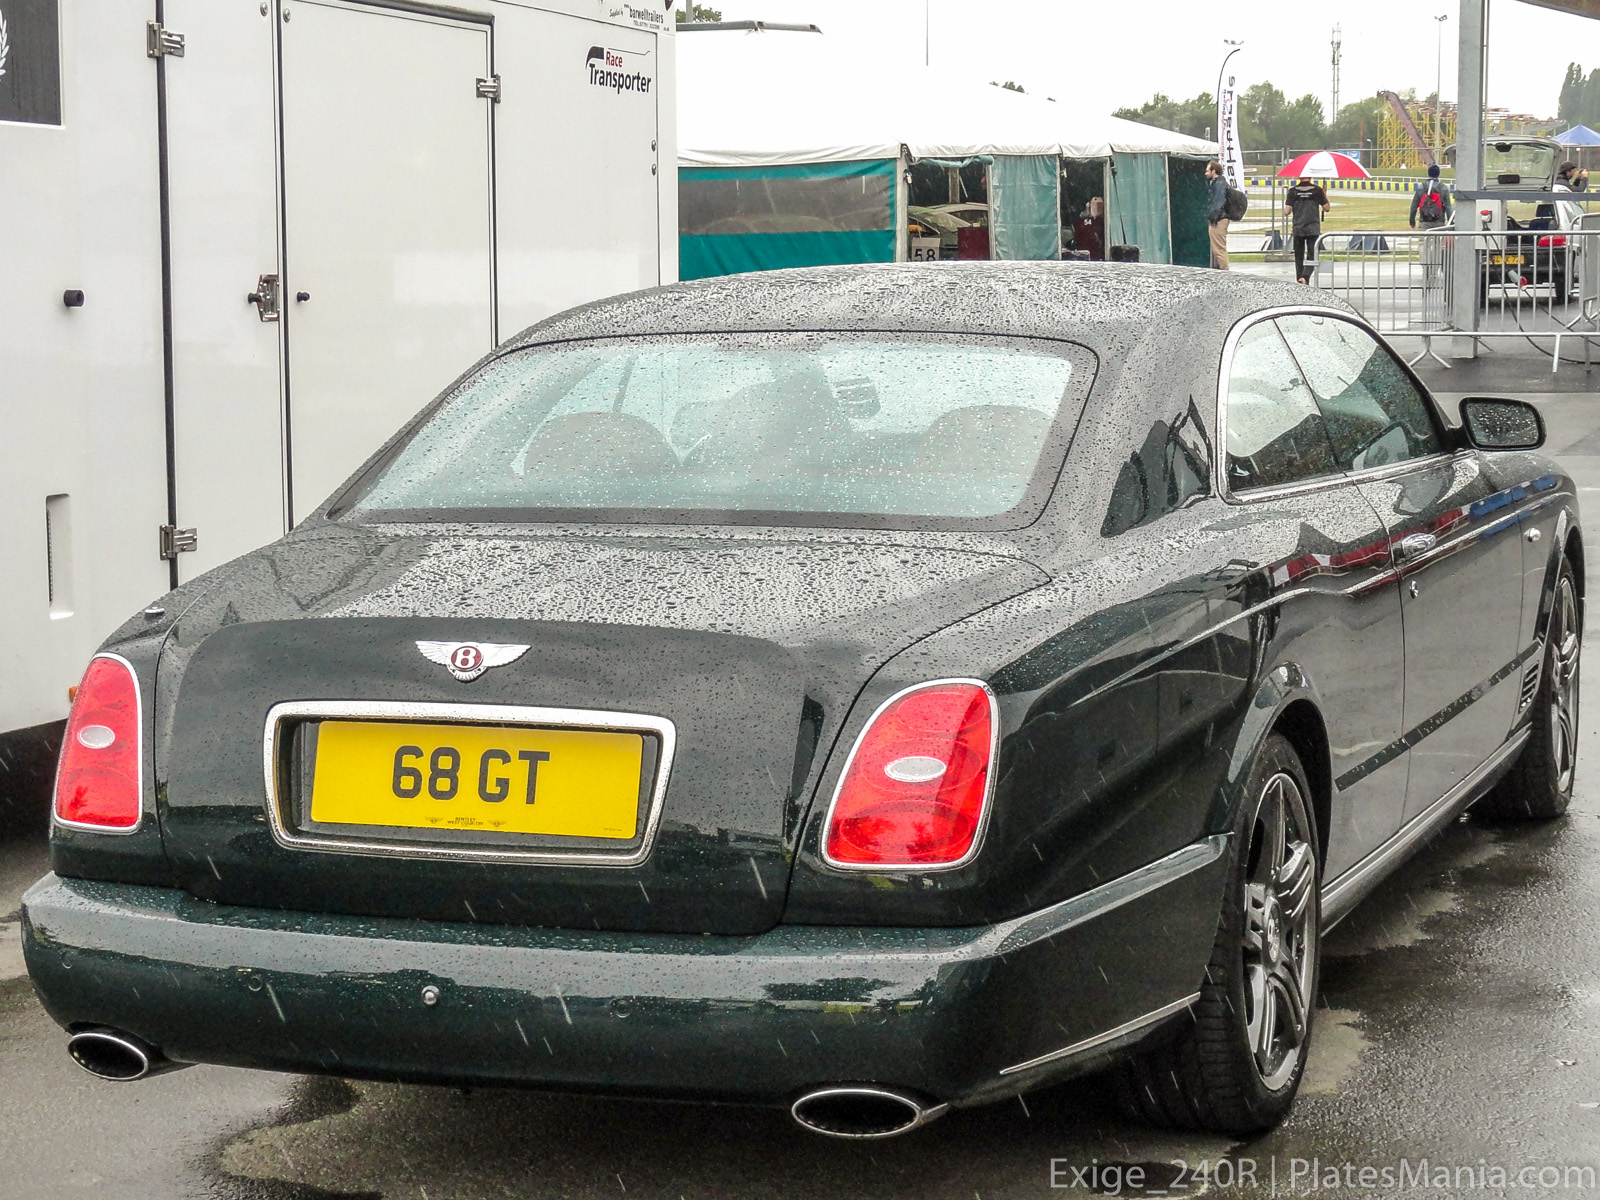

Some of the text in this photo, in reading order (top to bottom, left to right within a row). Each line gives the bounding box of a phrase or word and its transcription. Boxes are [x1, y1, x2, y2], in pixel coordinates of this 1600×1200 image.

[630, 5, 663, 24] barwelltrailers
[605, 51, 623, 67] Race
[589, 63, 651, 94] Transporter
[1226, 75, 1238, 188] SpeedHea
[914, 248, 936, 261] 58
[392, 745, 550, 804] 68 GT
